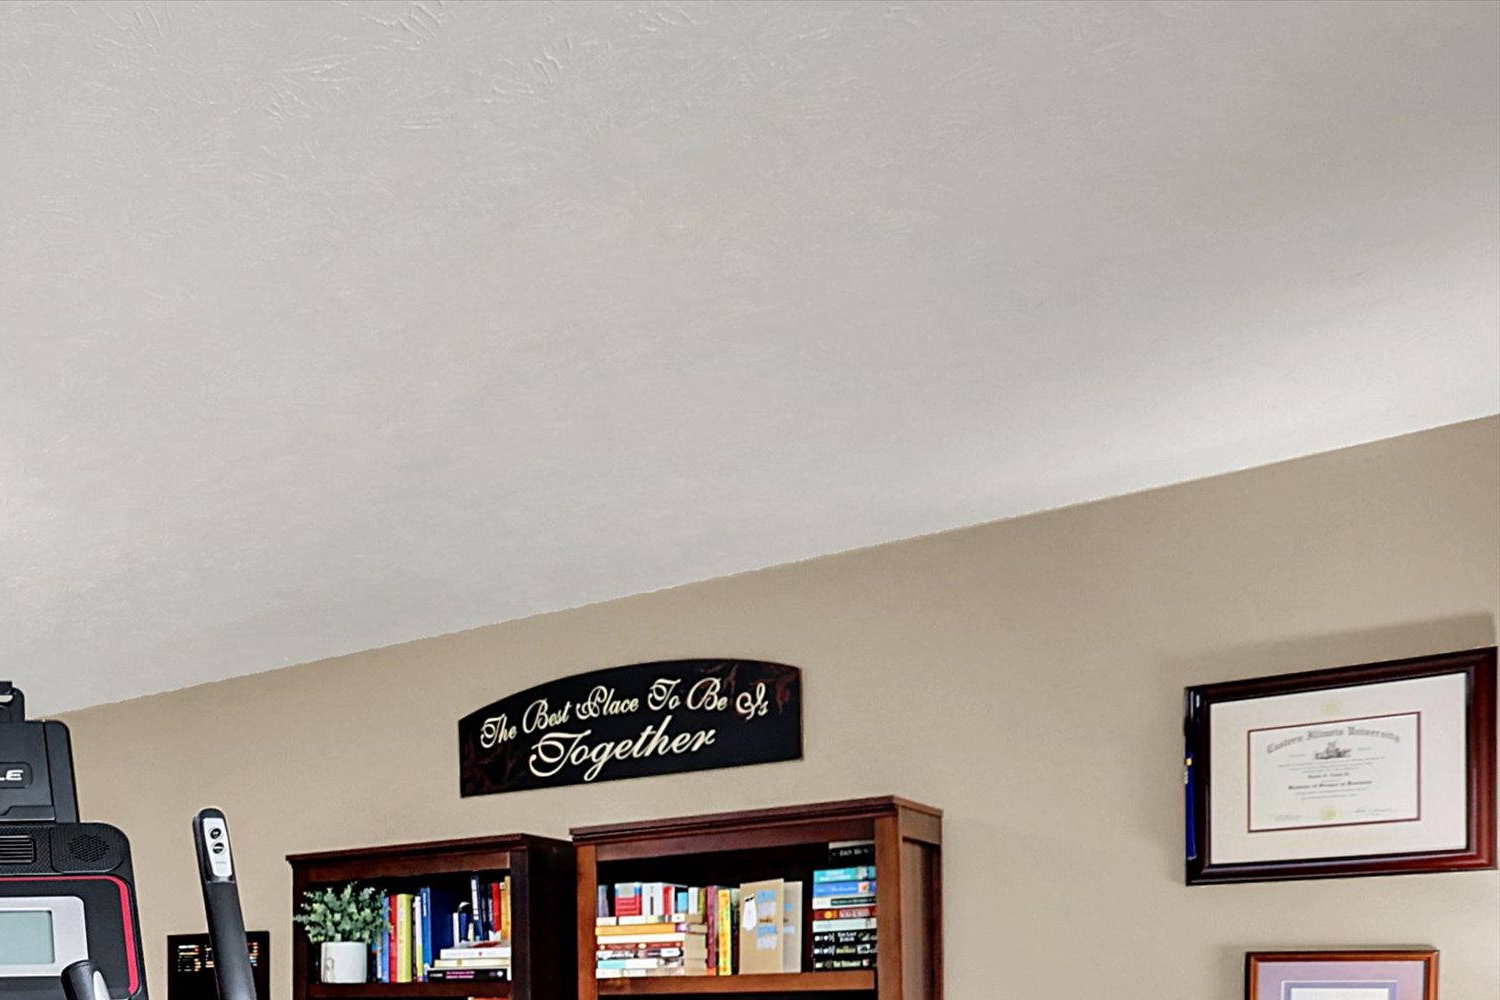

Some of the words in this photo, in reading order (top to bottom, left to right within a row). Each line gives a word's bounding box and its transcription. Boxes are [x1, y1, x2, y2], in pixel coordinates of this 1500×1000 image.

[480, 713, 517, 749] The
[522, 698, 570, 734] Best
[575, 685, 639, 721] Place
[647, 678, 682, 711] To
[686, 677, 728, 711] Be
[735, 682, 769, 720] Is
[1306, 728, 1344, 741] Illinois
[1347, 726, 1400, 743] University
[528, 714, 716, 781] Together
